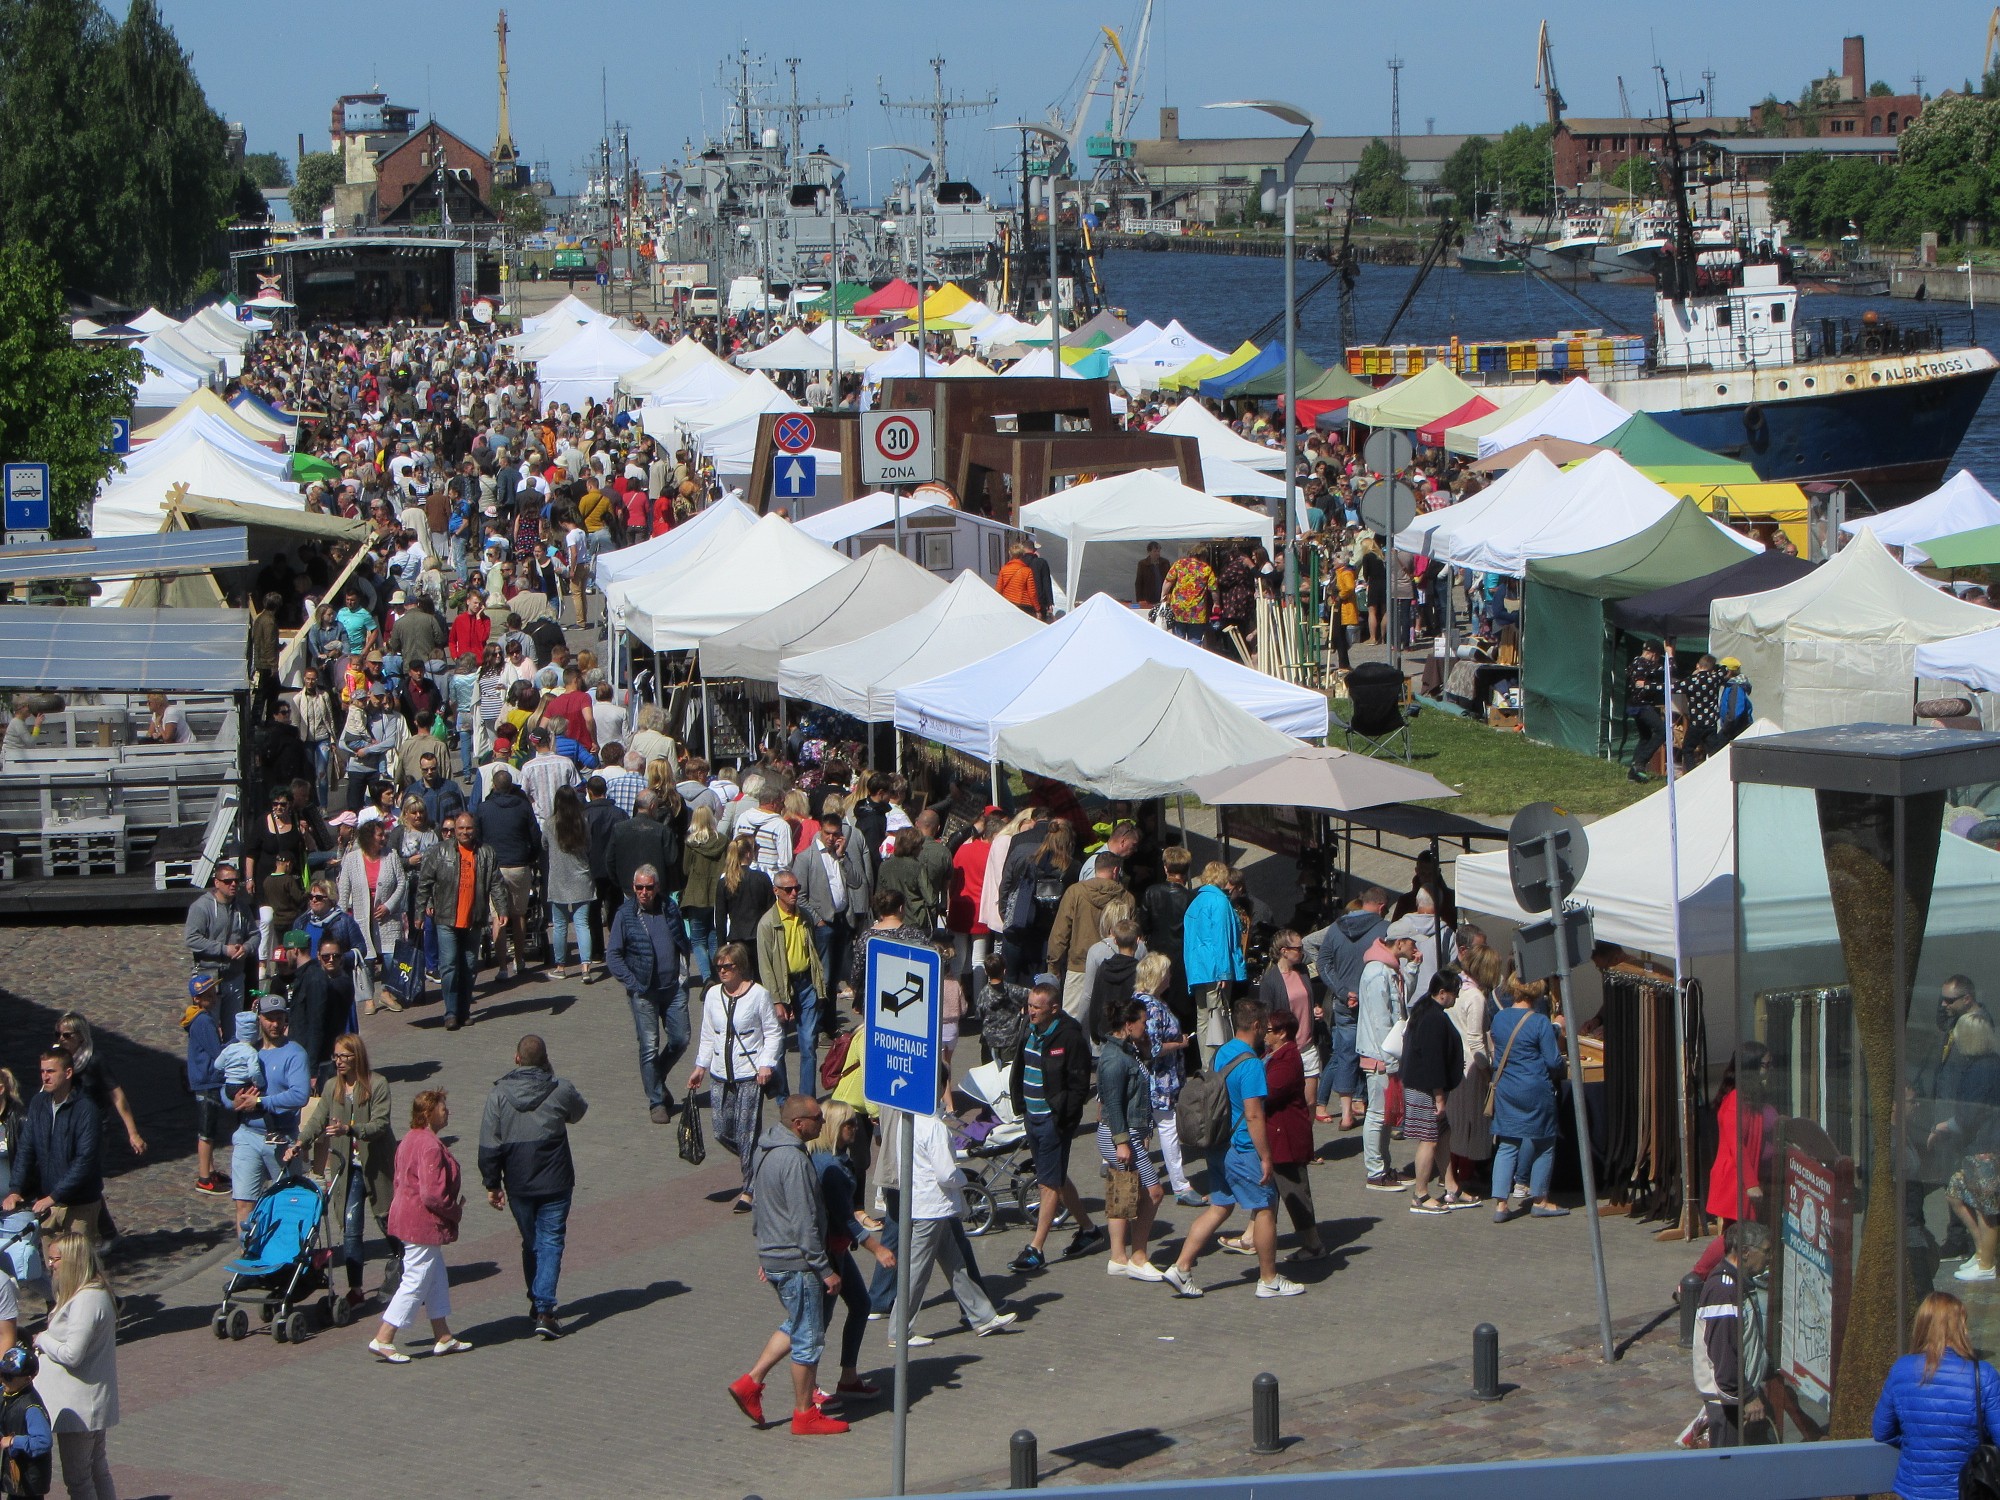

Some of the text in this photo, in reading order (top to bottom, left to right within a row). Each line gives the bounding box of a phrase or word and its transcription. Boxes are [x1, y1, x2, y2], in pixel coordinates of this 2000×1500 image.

[1885, 359, 1963, 381] ALBATROSS
[887, 428, 909, 449] 30
[881, 466, 916, 478] ZONA
[24, 508, 30, 517] 3
[874, 1031, 928, 1058] PROMENADE
[886, 1054, 914, 1074] HOTEL
[1801, 1168, 1816, 1186] CIEMA
[1789, 1184, 1799, 1202] 19.
[1821, 1205, 1831, 1226] 20.
[1789, 1232, 1826, 1269] PROGRAMMA
